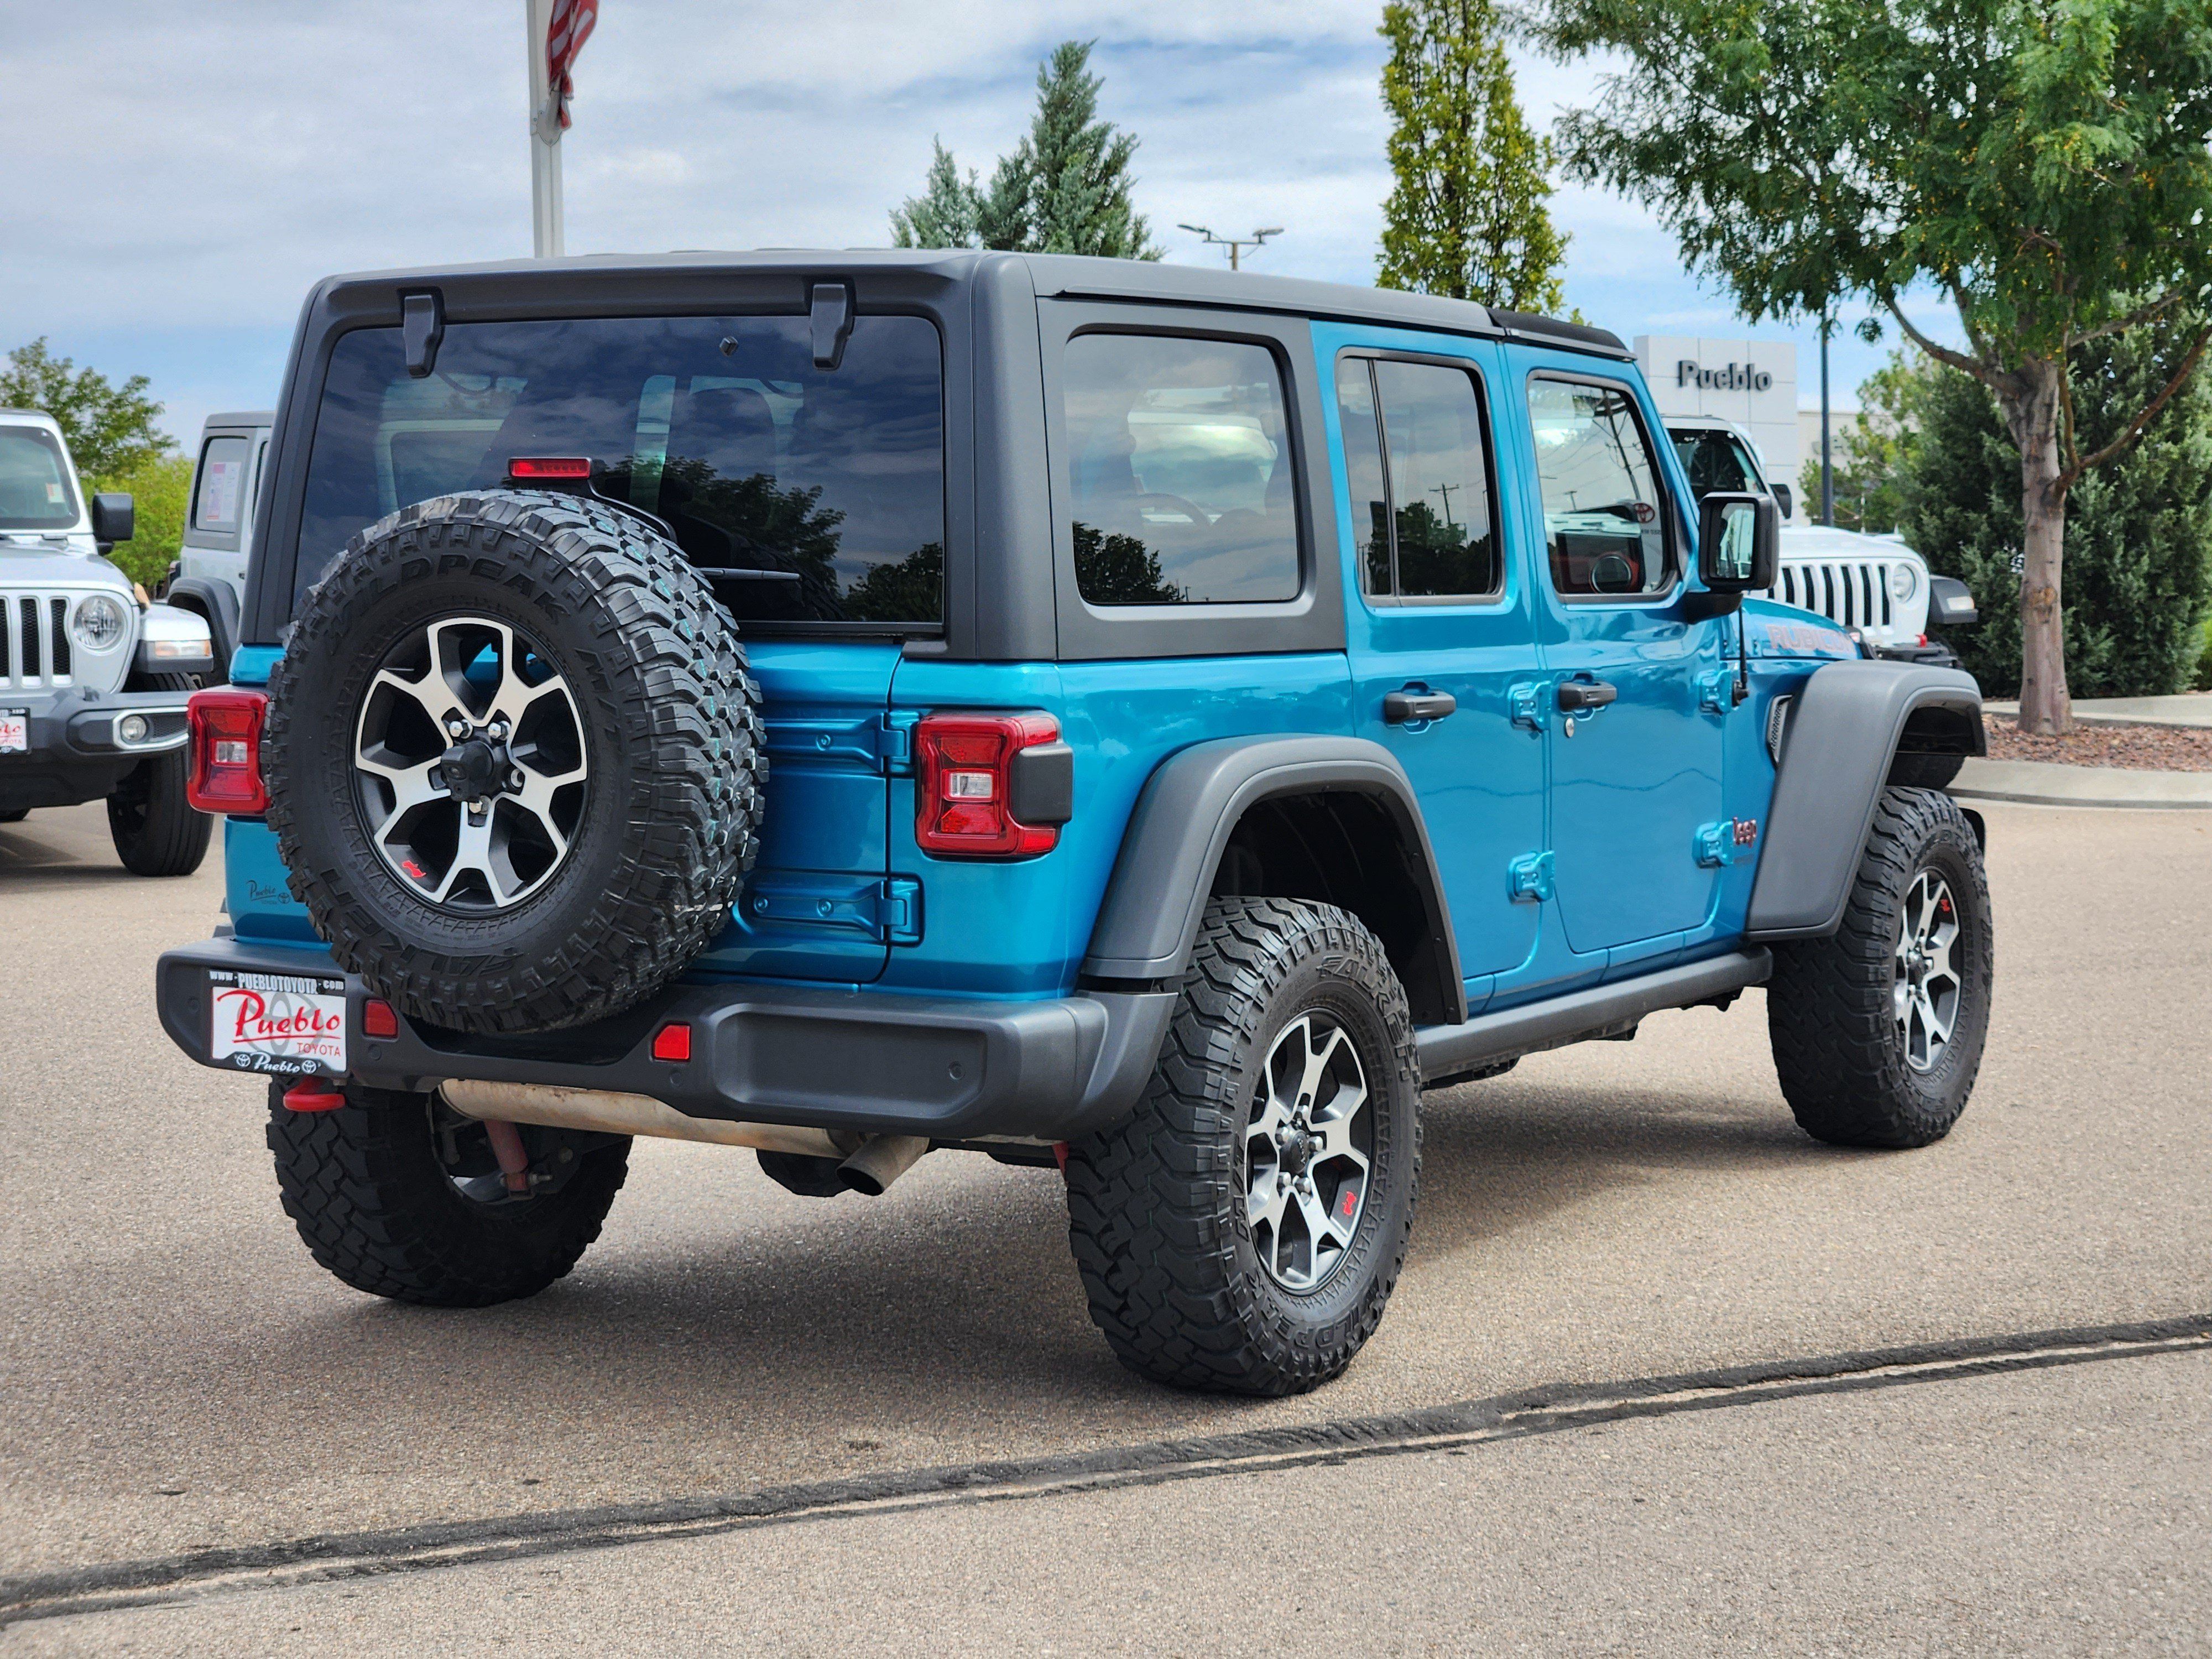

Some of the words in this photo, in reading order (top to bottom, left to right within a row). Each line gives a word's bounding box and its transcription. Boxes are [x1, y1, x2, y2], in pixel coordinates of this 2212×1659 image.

[1678, 360, 1772, 391] Pueblo
[324, 554, 572, 655] WILDPEAK
[1766, 624, 1851, 654] RUBICON
[1732, 817, 1757, 848] Jeep
[319, 868, 525, 977] FALKEN
[217, 989, 340, 1037] Pueblo
[1316, 954, 1413, 1082] FALKEN
[251, 1051, 301, 1073] Pueblo
[296, 1042, 341, 1057] TOYOTA
